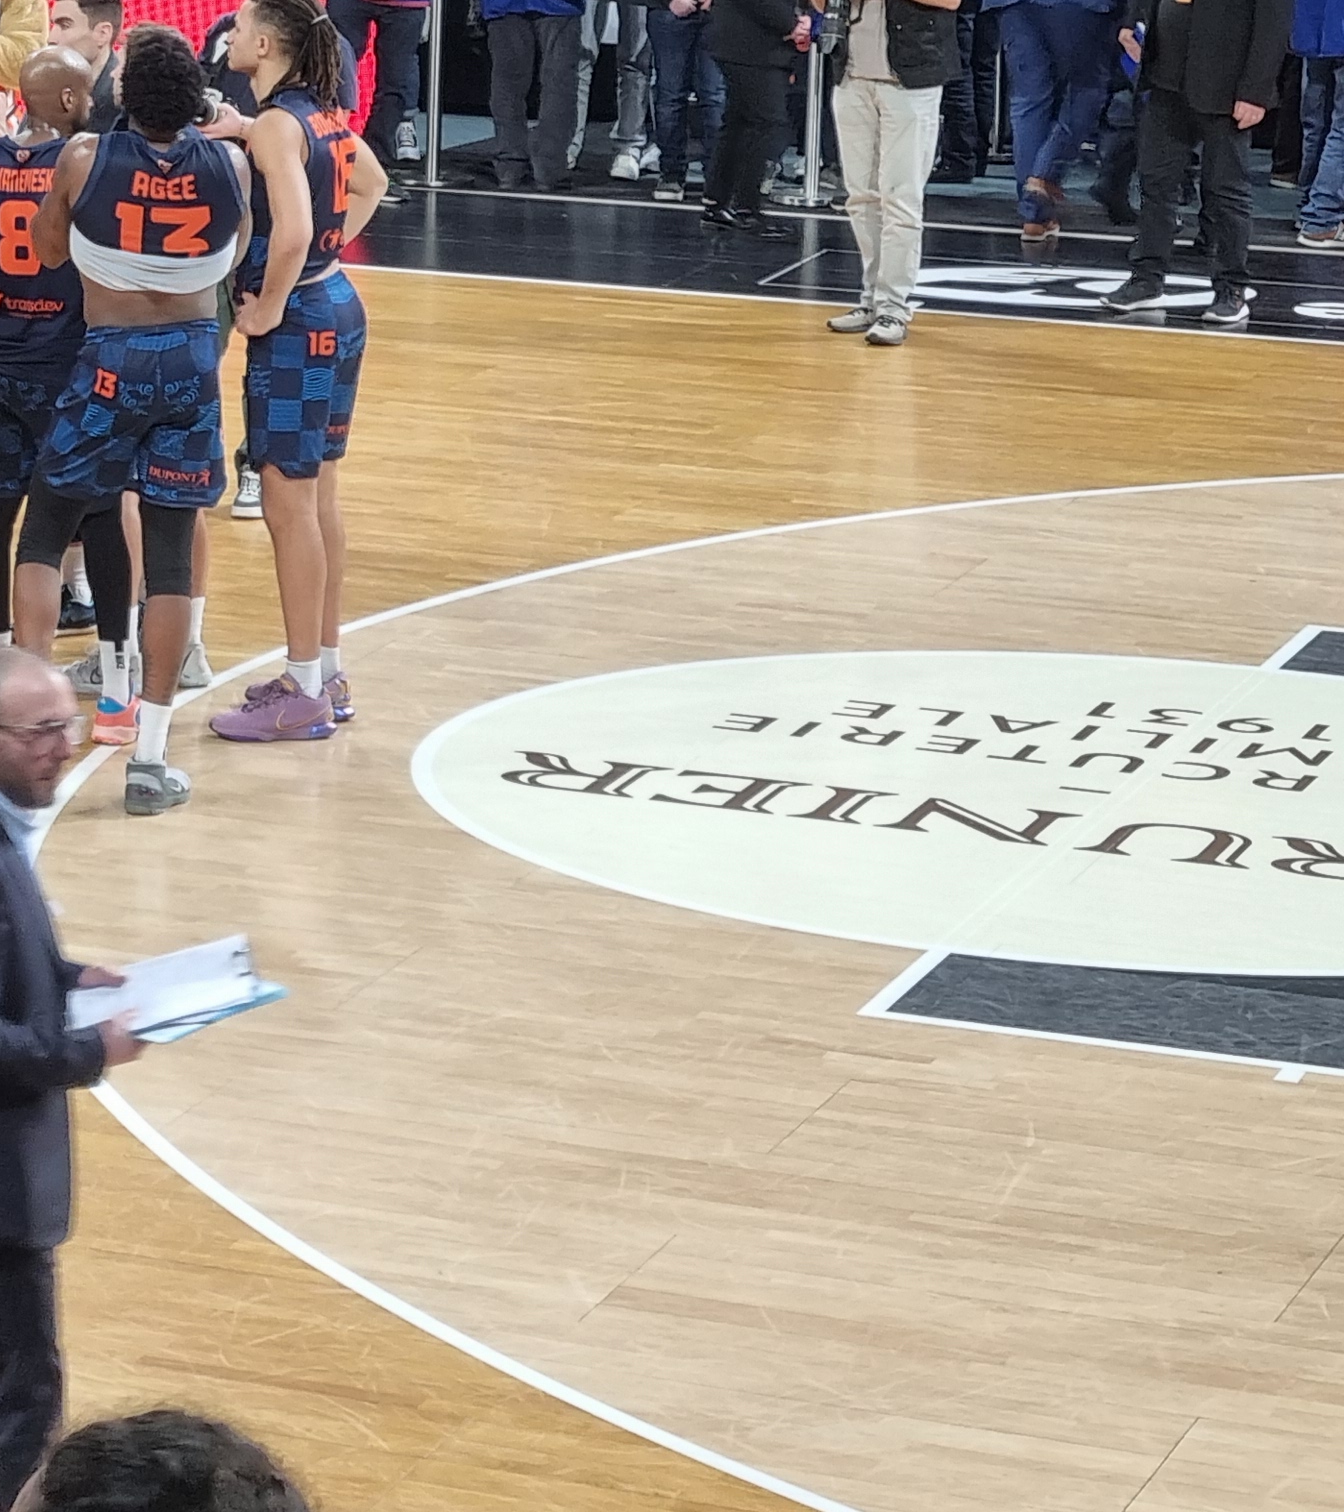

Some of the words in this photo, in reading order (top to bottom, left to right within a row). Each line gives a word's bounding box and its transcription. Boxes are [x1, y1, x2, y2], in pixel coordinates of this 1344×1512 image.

[131, 170, 199, 201] AGEE
[115, 201, 212, 258] 13
[308, 330, 337, 358] 16
[94, 366, 118, 400] 13
[1087, 700, 1332, 742] 1931
